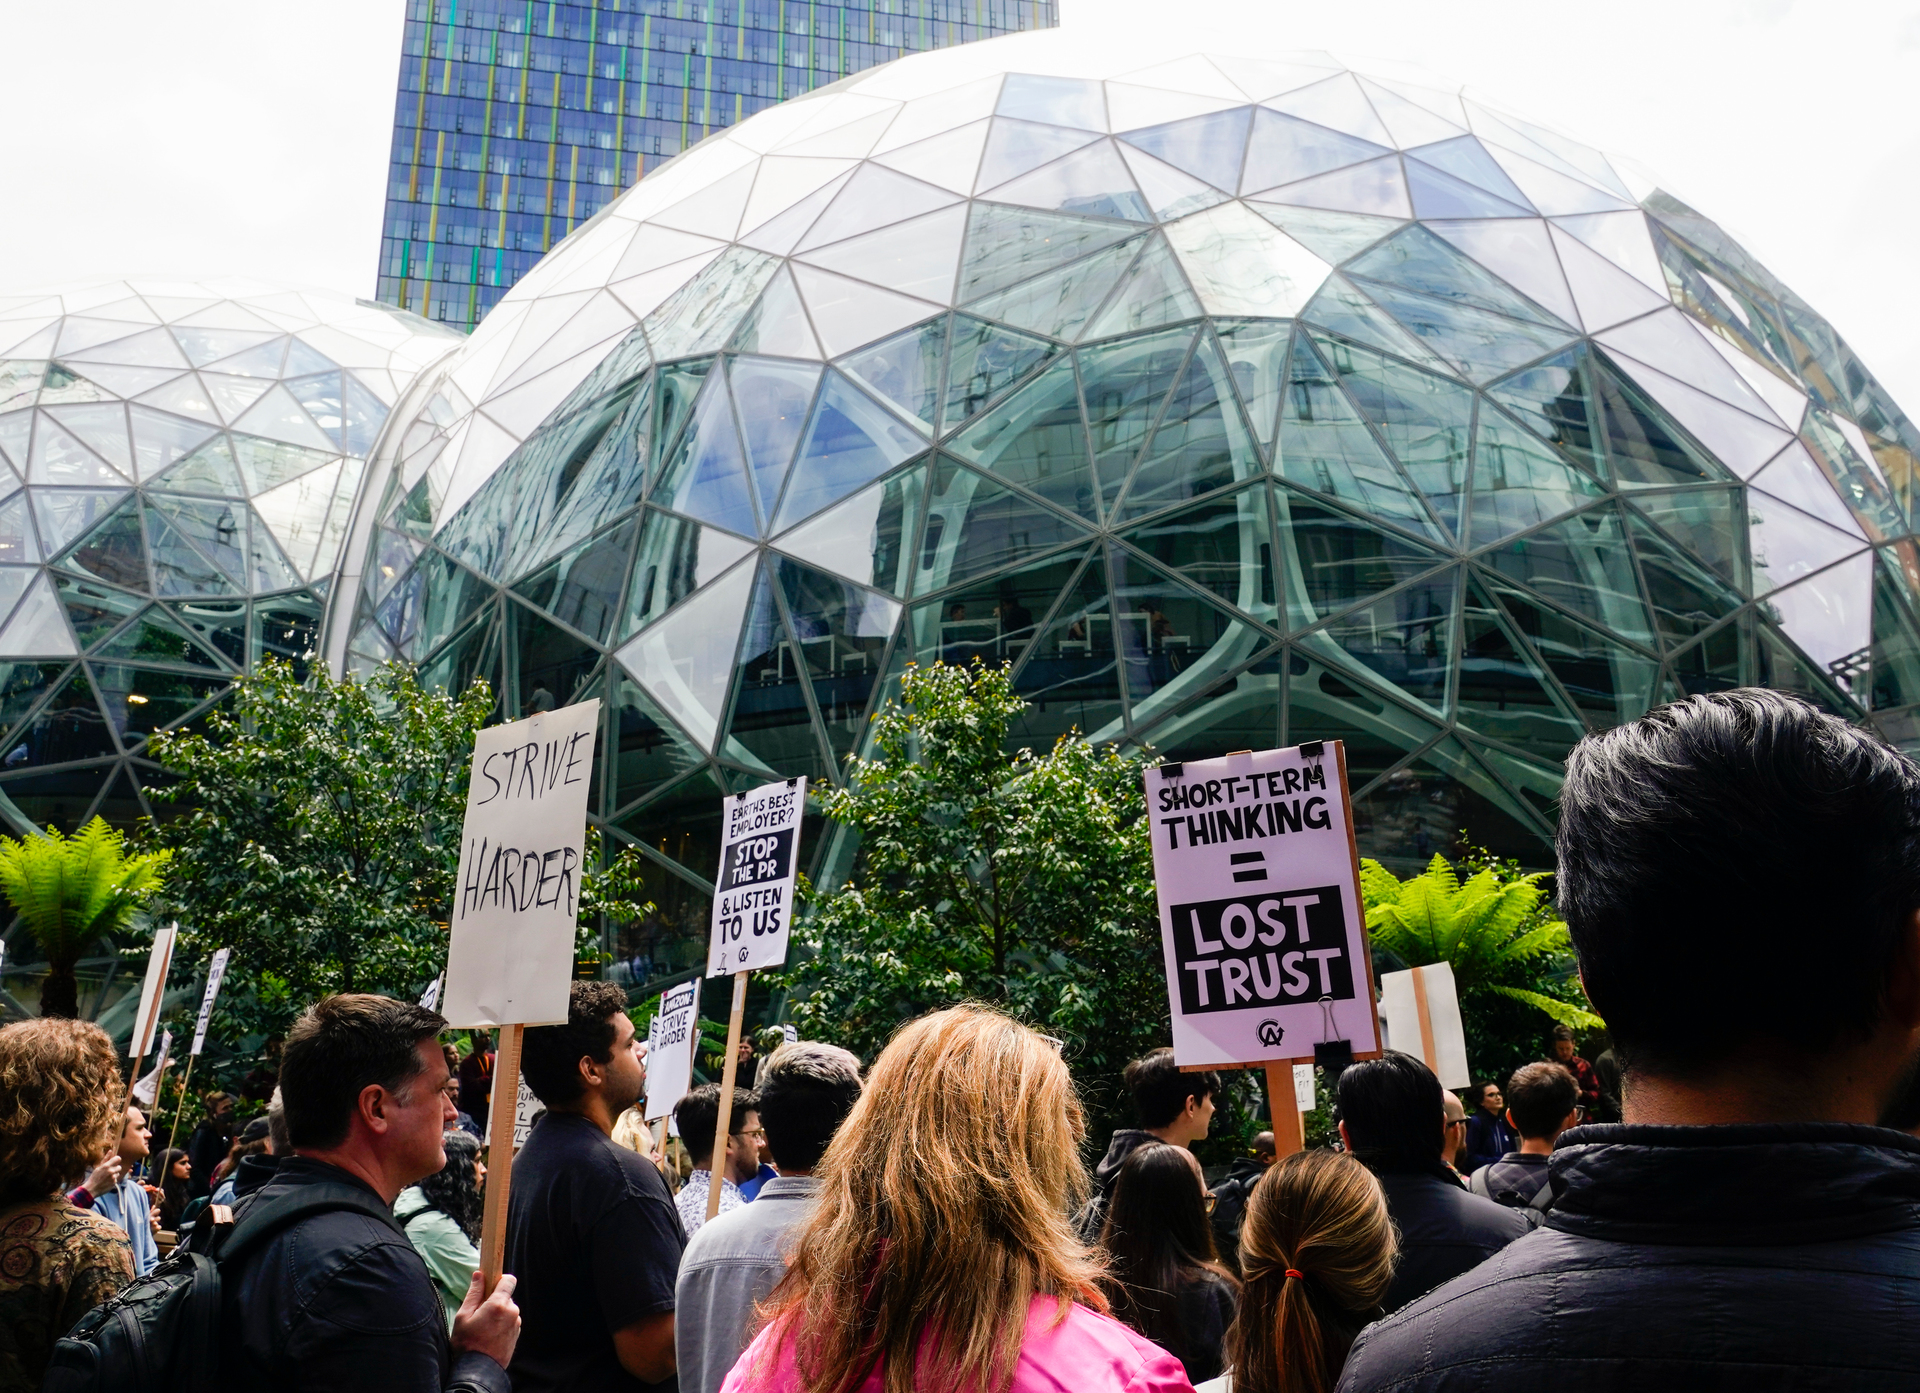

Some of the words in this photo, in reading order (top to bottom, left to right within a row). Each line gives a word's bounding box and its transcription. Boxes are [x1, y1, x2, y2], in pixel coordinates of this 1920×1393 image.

[477, 731, 590, 805] STRIVE
[1158, 765, 1327, 812] SHORT-TERM
[730, 807, 794, 838] EMPLOYER?
[732, 798, 765, 822] EARTH'S
[769, 792, 796, 809] BEST
[1160, 797, 1332, 850] THINKING
[735, 836, 779, 866] STOP
[461, 837, 578, 920] HARDER
[732, 864, 753, 885] THE
[757, 859, 778, 880] PR
[722, 897, 731, 916] &
[733, 887, 782, 912] LISTEN
[719, 915, 743, 945] TO
[753, 908, 782, 937] US
[1189, 894, 1320, 955] LOST
[1184, 947, 1342, 1007] TRUST
[659, 1027, 687, 1050] HARDER
[661, 1010, 689, 1034] STRIVE
